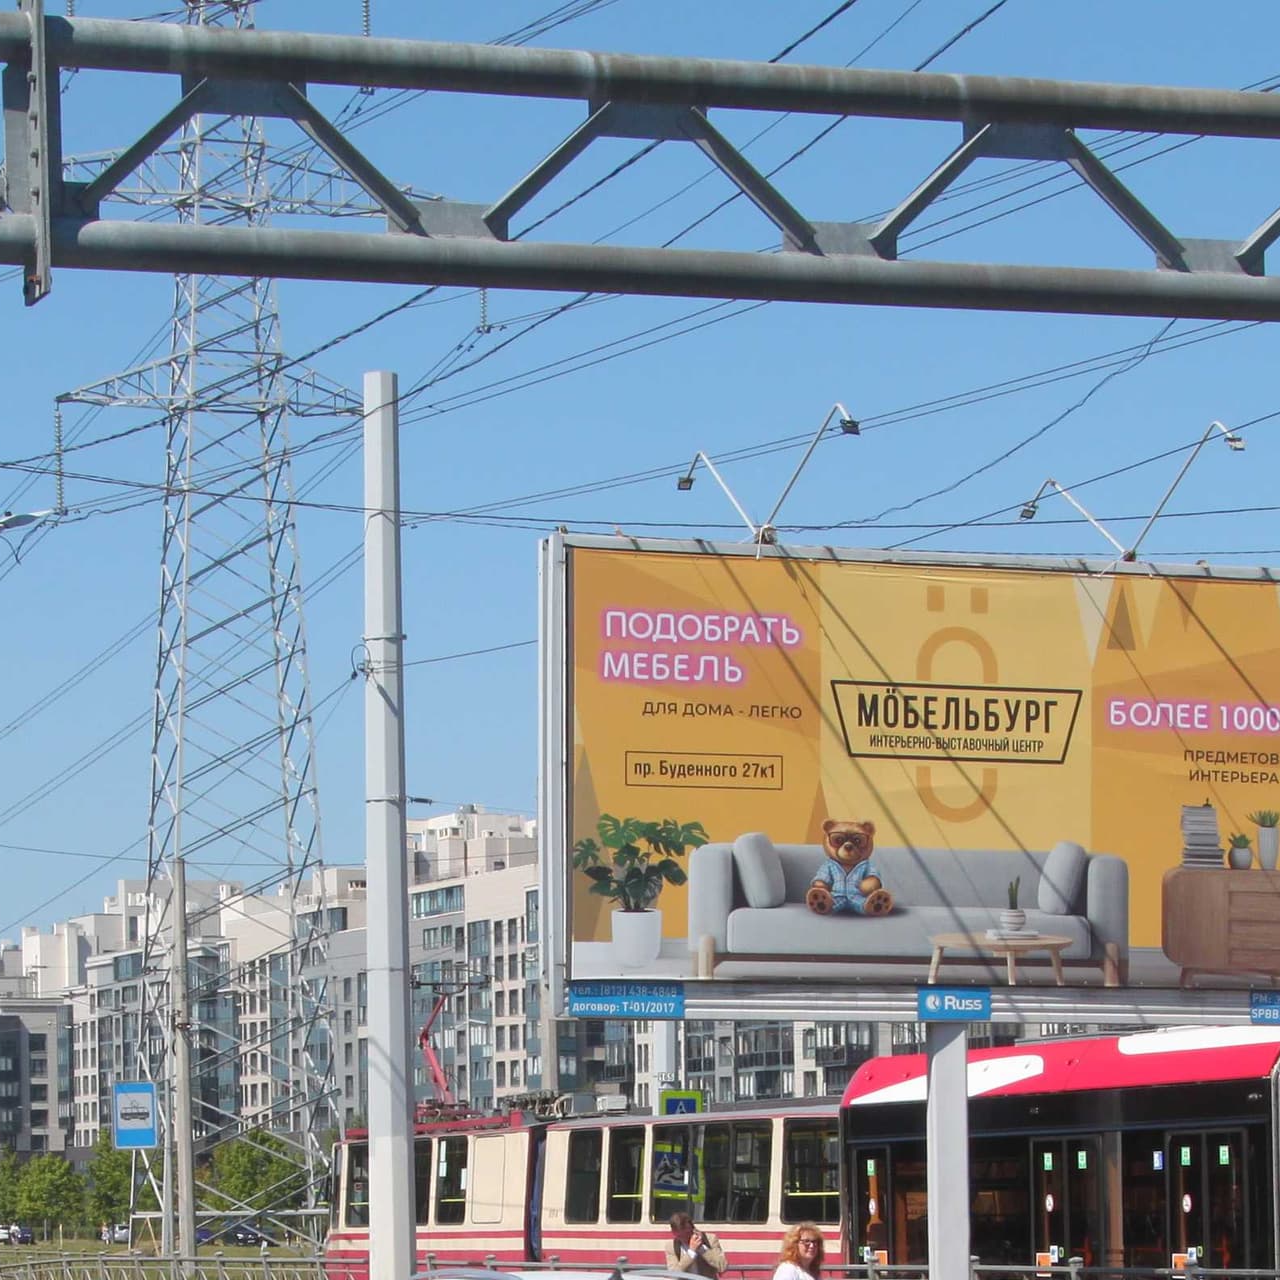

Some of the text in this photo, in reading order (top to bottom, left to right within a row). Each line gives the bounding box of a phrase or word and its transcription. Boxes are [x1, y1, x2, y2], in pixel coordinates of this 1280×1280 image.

[605, 610, 800, 645] ПОДОБРАТЬ
[603, 651, 743, 683] МЕБЕЛЬ
[642, 701, 678, 716] ДЛЯ
[682, 702, 734, 717] ДОМА
[748, 704, 803, 720] ЛЕГКО
[1109, 700, 1280, 732] БОЛЕЕ 1000
[869, 734, 1044, 754] ИНТЕРЬЕРНО-ВЫСТАВОЧНЫЙ ЦЕНТР
[1183, 749, 1280, 765] ПРЕДМЕТОВ
[634, 760, 776, 779] пр. Буденного 27к1
[1188, 769, 1280, 784] ИНТЕРЬЕРА
[571, 1002, 620, 1015] договор:
[944, 995, 983, 1010] Russ
